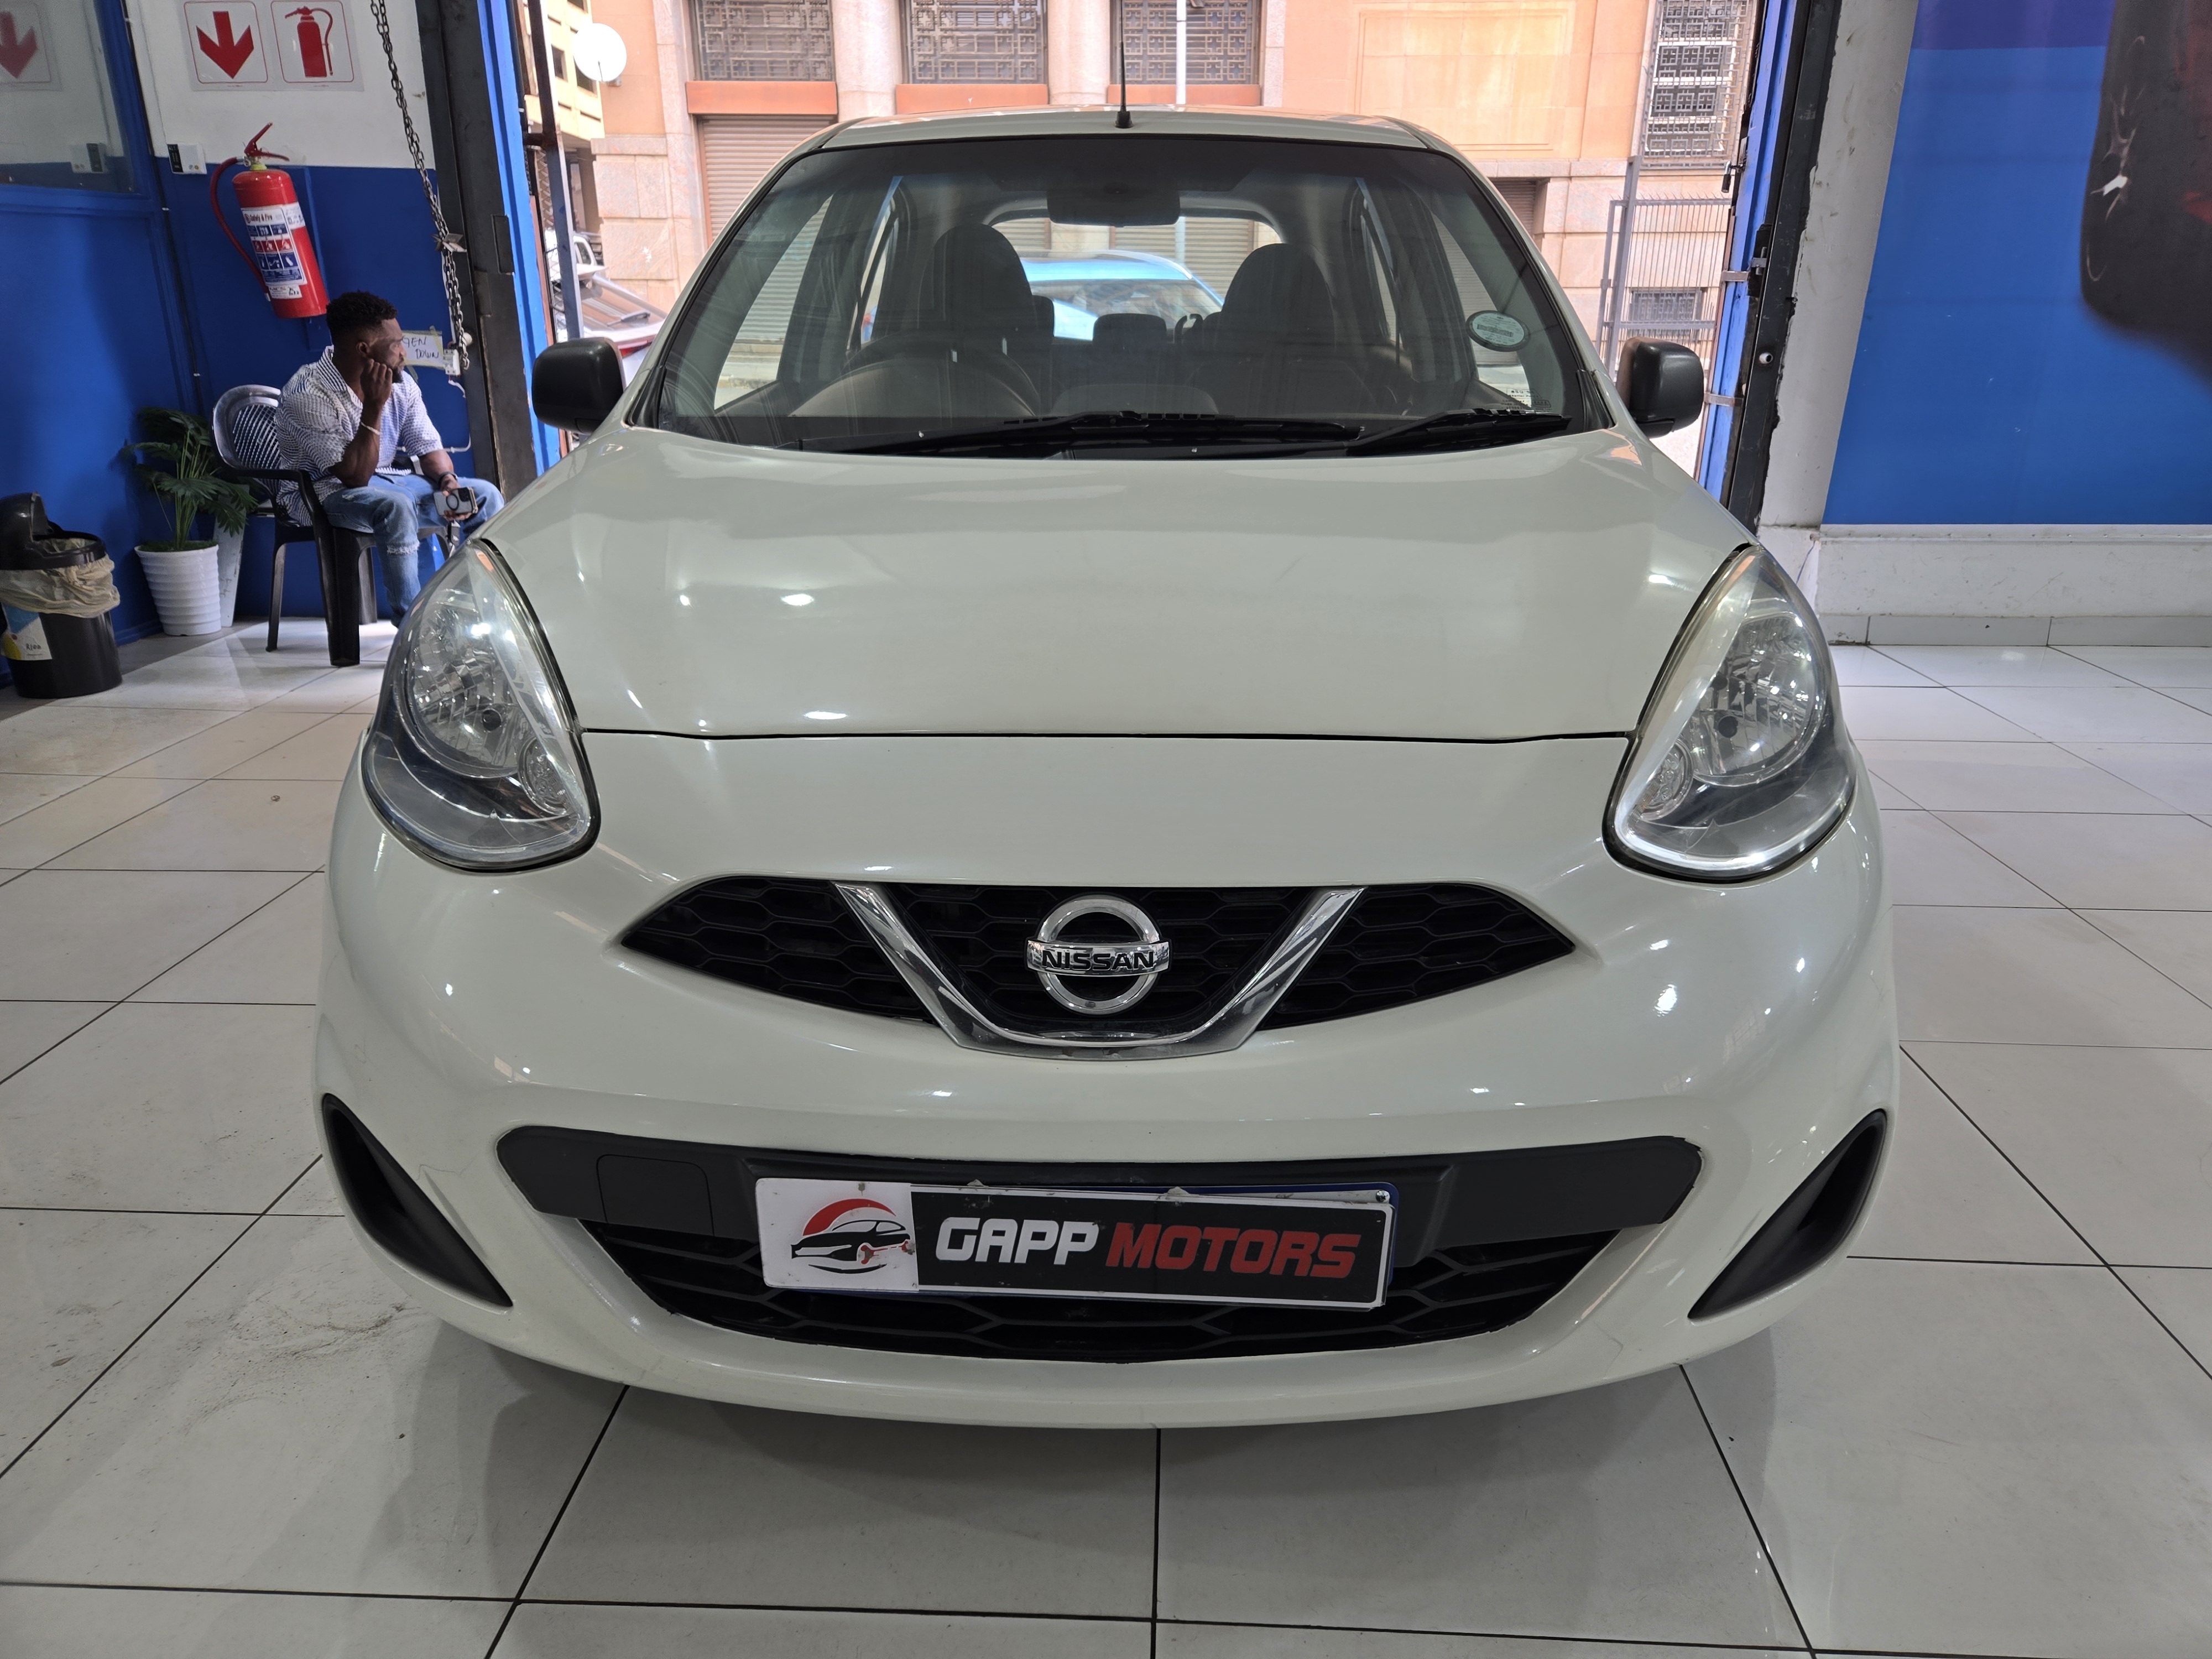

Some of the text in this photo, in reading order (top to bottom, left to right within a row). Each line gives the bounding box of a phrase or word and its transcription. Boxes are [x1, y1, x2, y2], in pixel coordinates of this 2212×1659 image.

[415, 348, 439, 359] DOWN
[1042, 950, 1154, 971] NISSAN
[936, 1217, 1361, 1279] GAPP MOTORS
